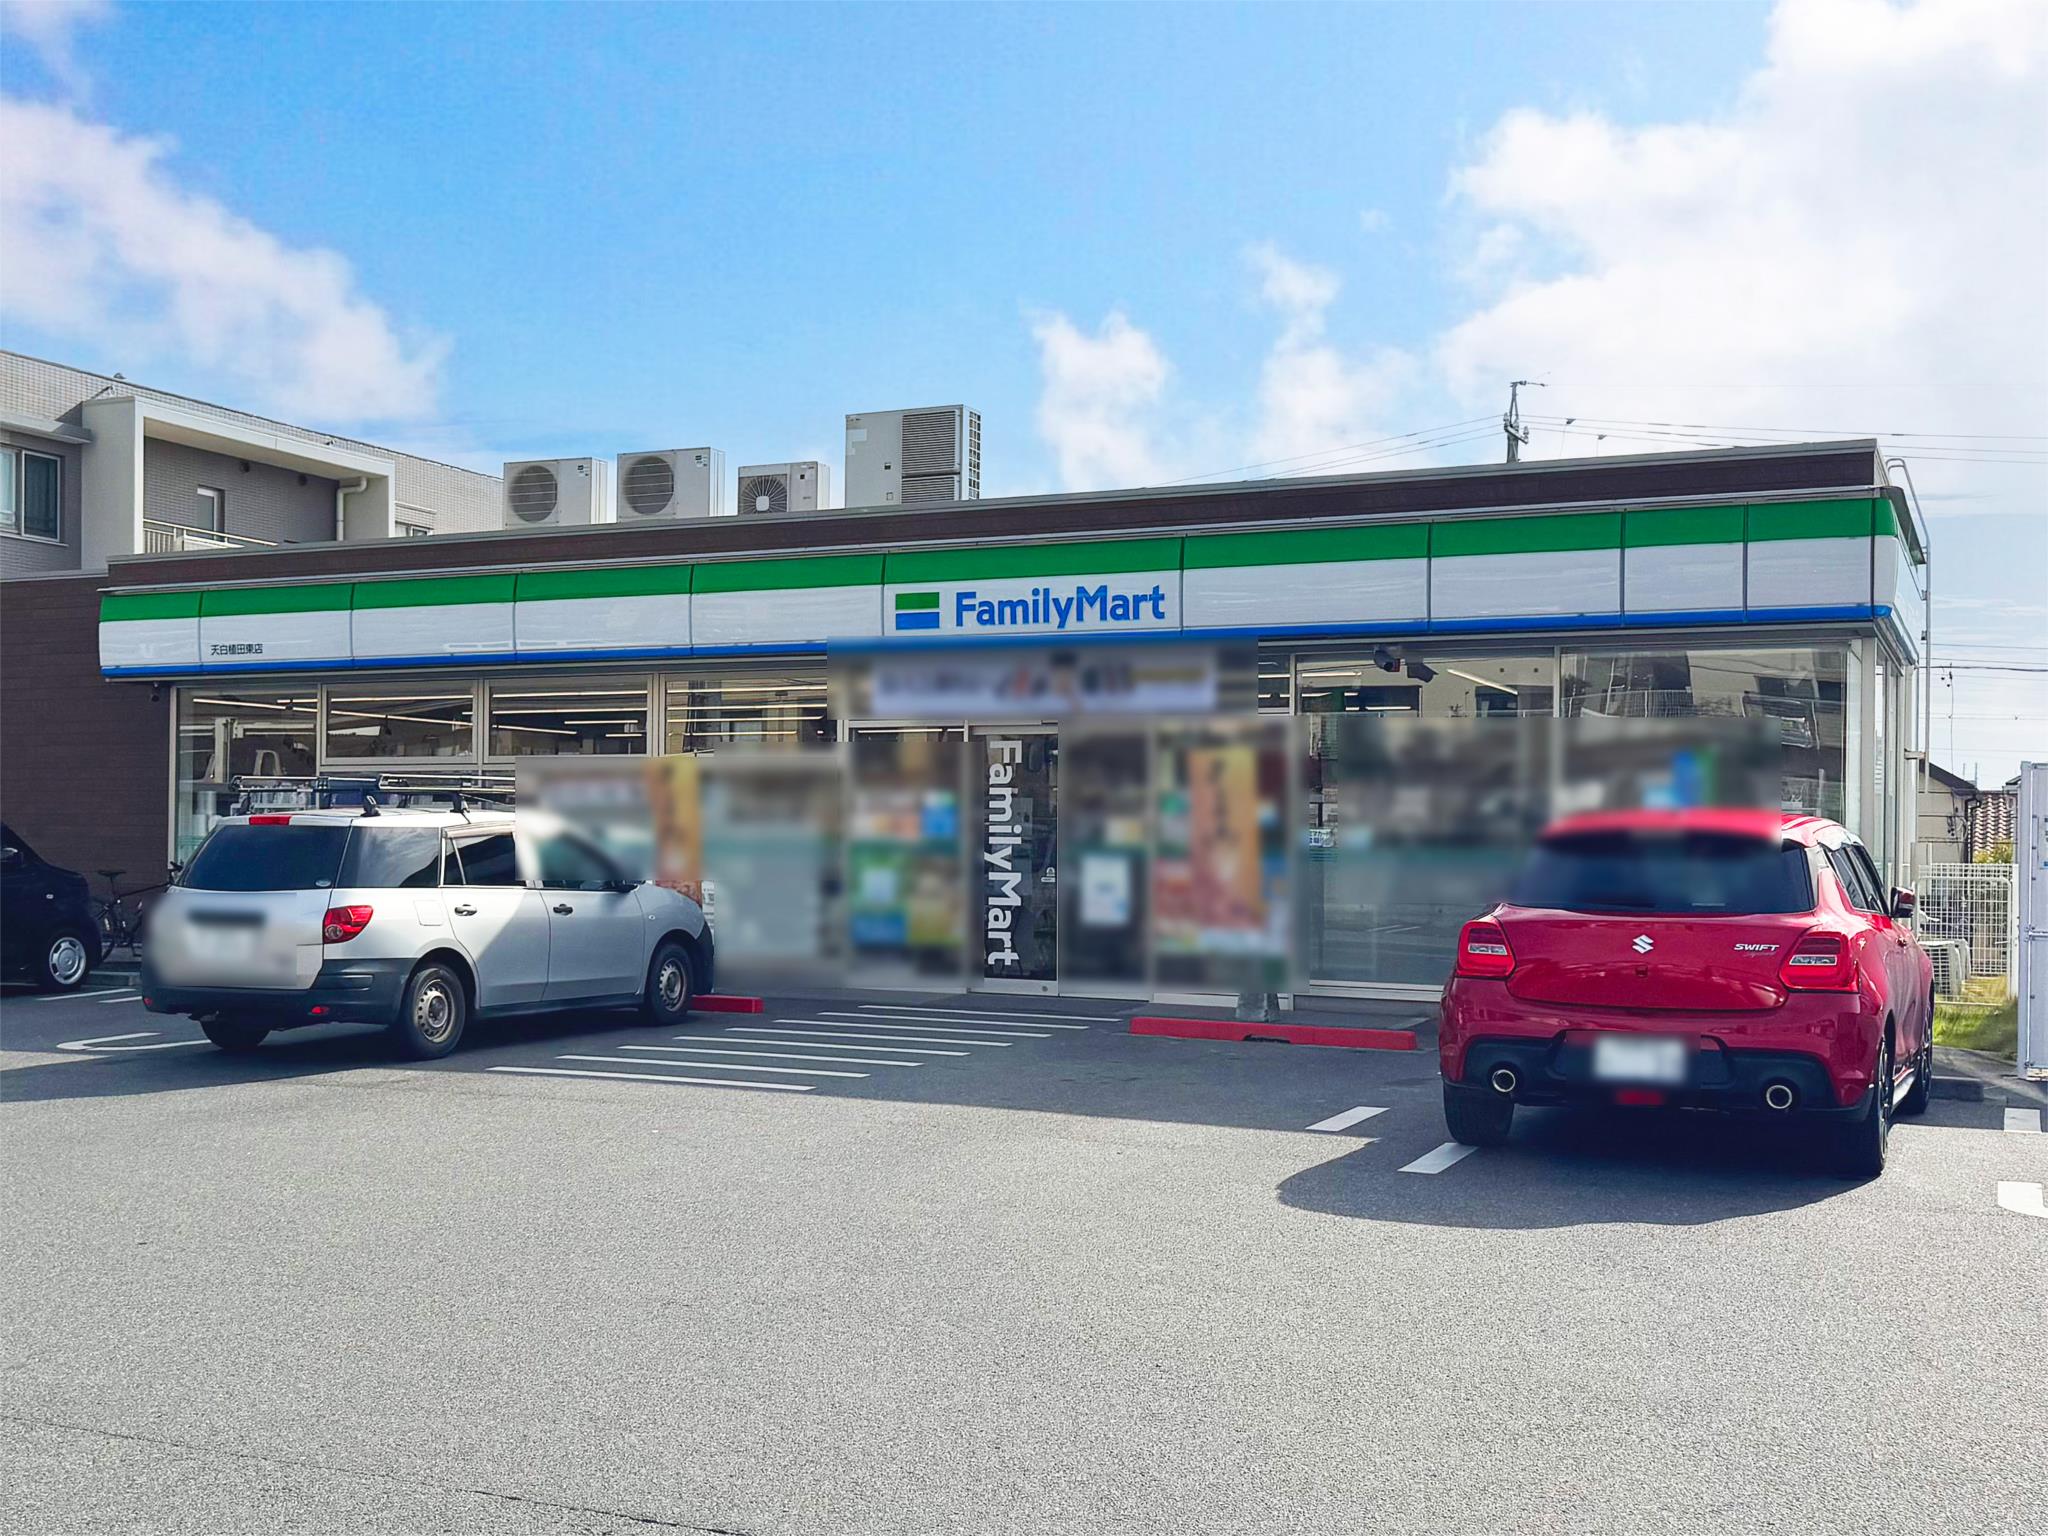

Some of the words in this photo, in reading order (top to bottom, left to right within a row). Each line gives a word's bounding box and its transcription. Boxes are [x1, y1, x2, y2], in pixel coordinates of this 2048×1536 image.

[956, 585, 1165, 629] FamilyMart
[210, 643, 263, 656] 天白植田東店
[984, 740, 1023, 966] FamilyMart
[1734, 943, 1780, 951] SWIFT
